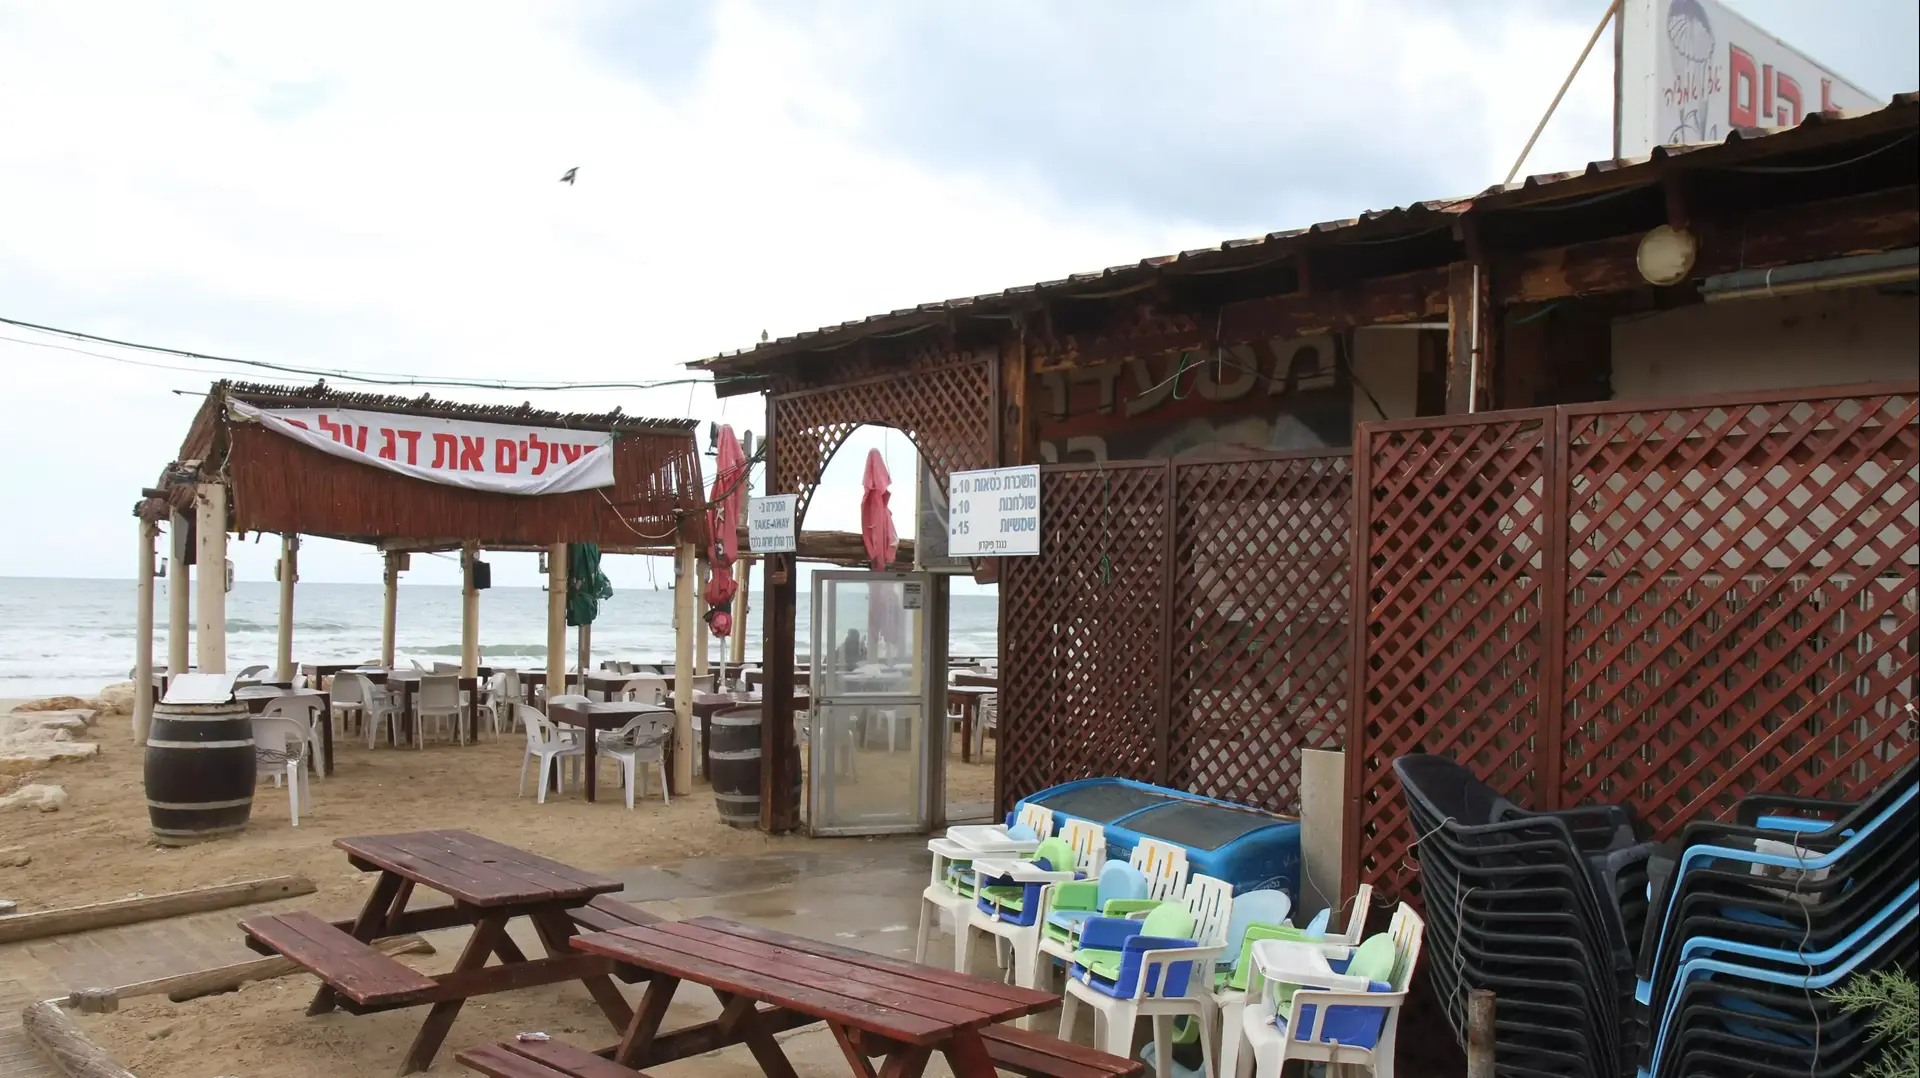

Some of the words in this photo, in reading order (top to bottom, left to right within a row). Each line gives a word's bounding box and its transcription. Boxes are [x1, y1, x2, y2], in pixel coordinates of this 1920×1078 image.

[318, 414, 368, 453] על
[378, 428, 422, 466] דג
[431, 433, 485, 472] את
[495, 433, 599, 475] צילים
[959, 479, 970, 493] 10
[973, 477, 1001, 492] כסאות
[1004, 474, 1036, 490] השכרת
[959, 500, 970, 514] 10
[999, 493, 1036, 511] שולחנות
[958, 520, 970, 534] 15
[1000, 517, 1036, 532] שמשיות
